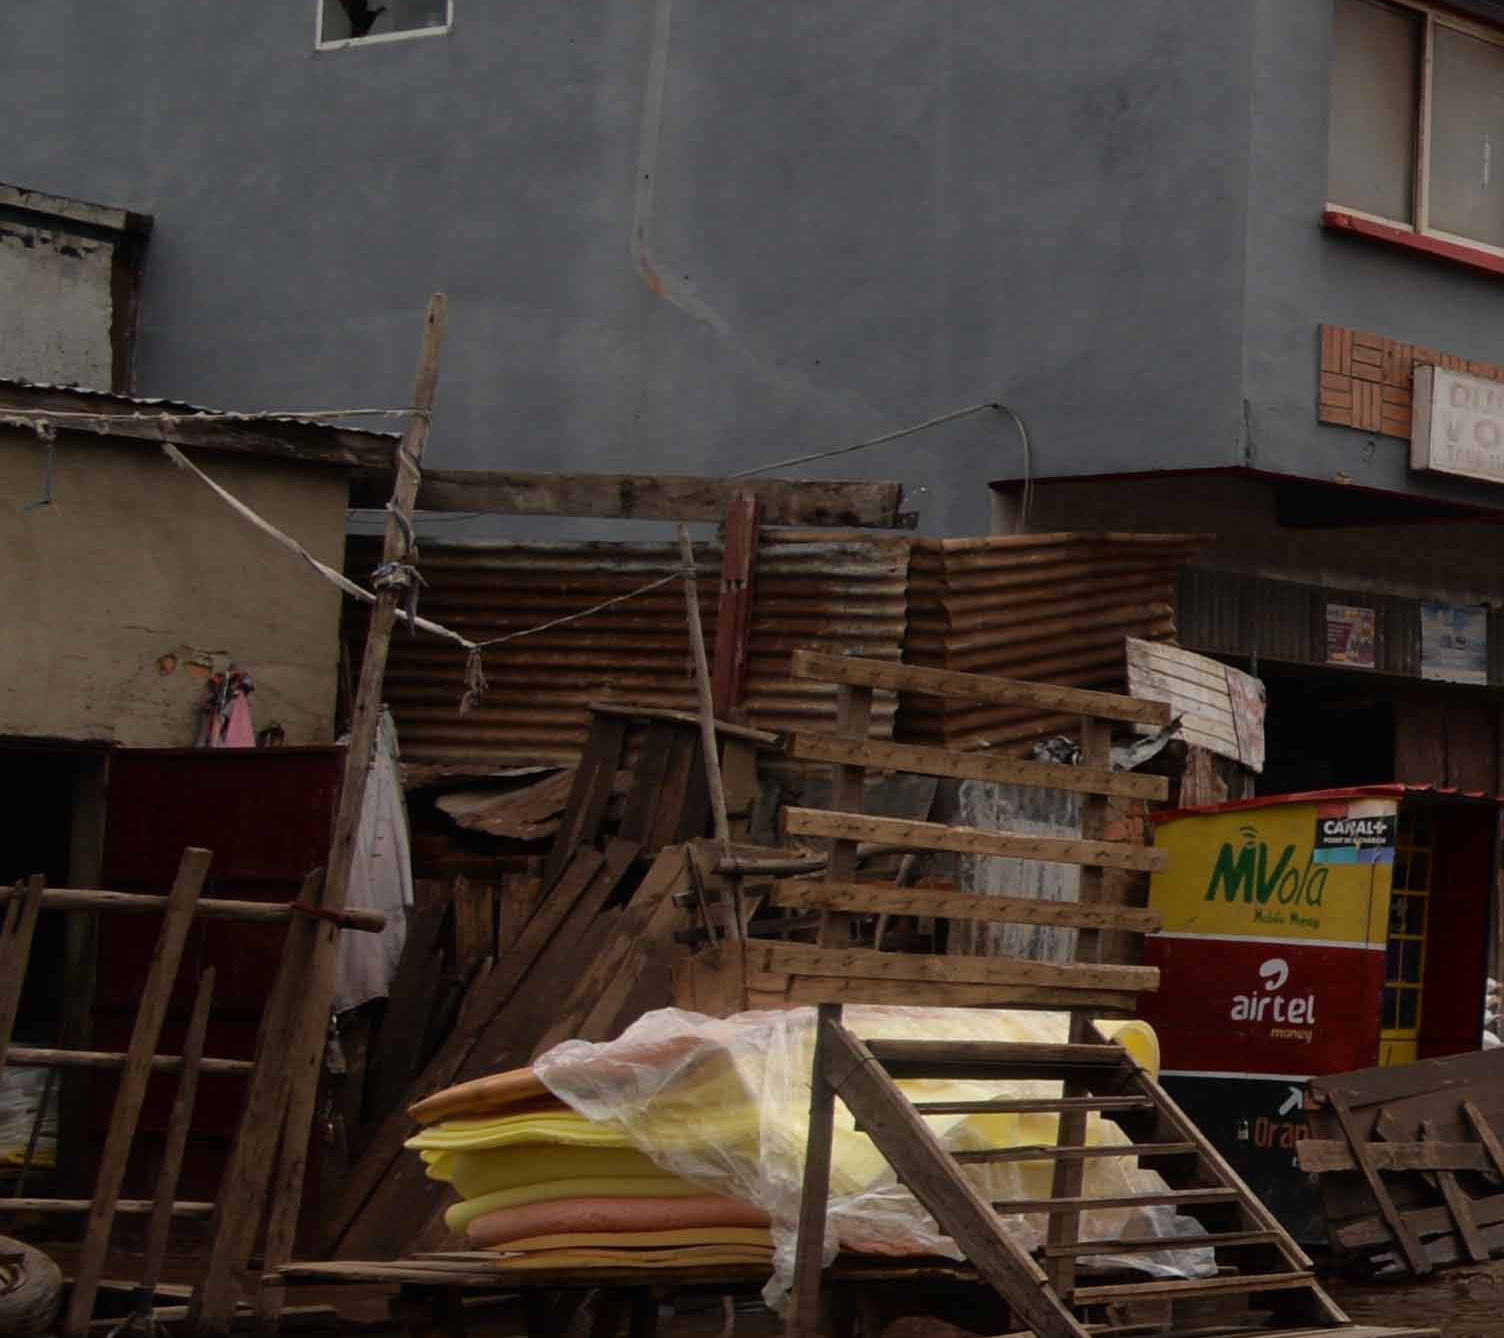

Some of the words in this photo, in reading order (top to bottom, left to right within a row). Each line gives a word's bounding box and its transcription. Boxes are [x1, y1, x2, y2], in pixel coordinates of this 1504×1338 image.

[1323, 820, 1387, 836] CANAL+
[1204, 841, 1328, 907] MVola
[1231, 990, 1315, 1024] airtel
[1270, 1028, 1312, 1043] money
